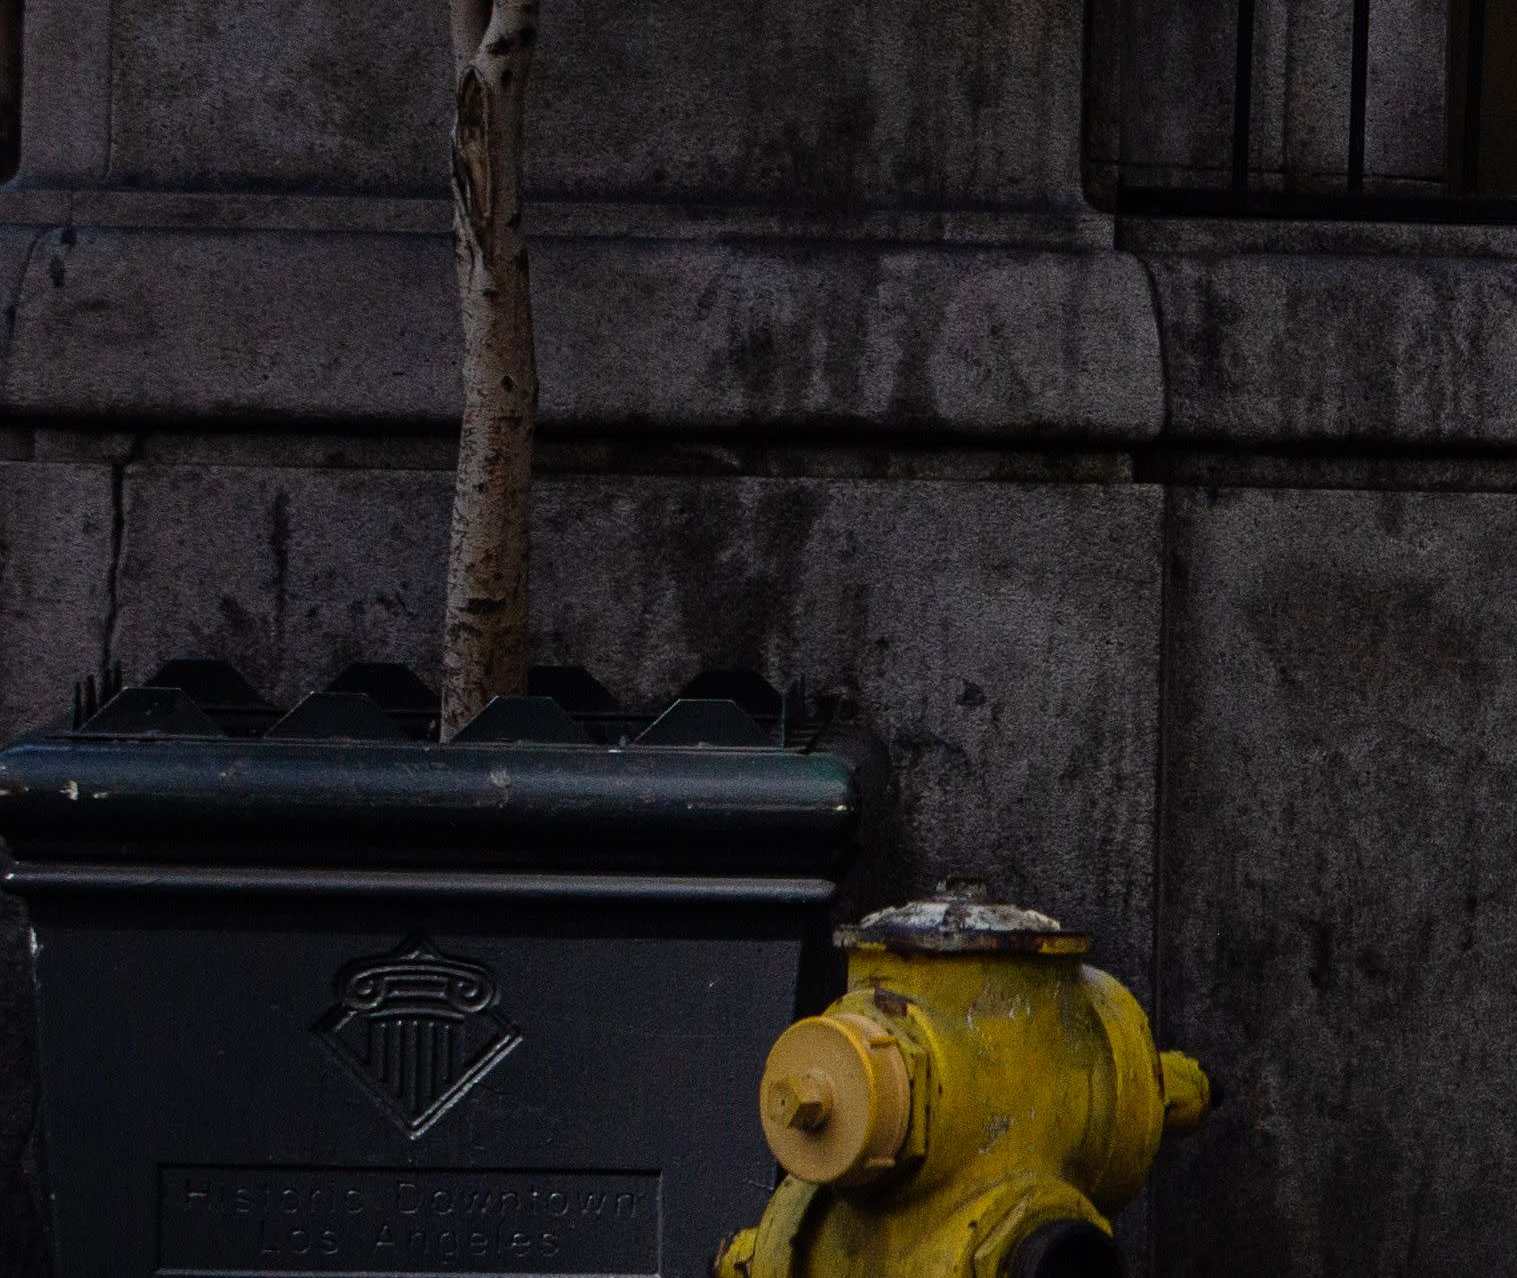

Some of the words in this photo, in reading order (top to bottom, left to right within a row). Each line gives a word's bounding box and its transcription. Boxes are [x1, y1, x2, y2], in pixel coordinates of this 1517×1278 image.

[183, 1178, 365, 1215] Historic
[399, 1180, 641, 1219] Downtown
[261, 1221, 339, 1258] Los
[374, 1223, 562, 1266] Angeles
